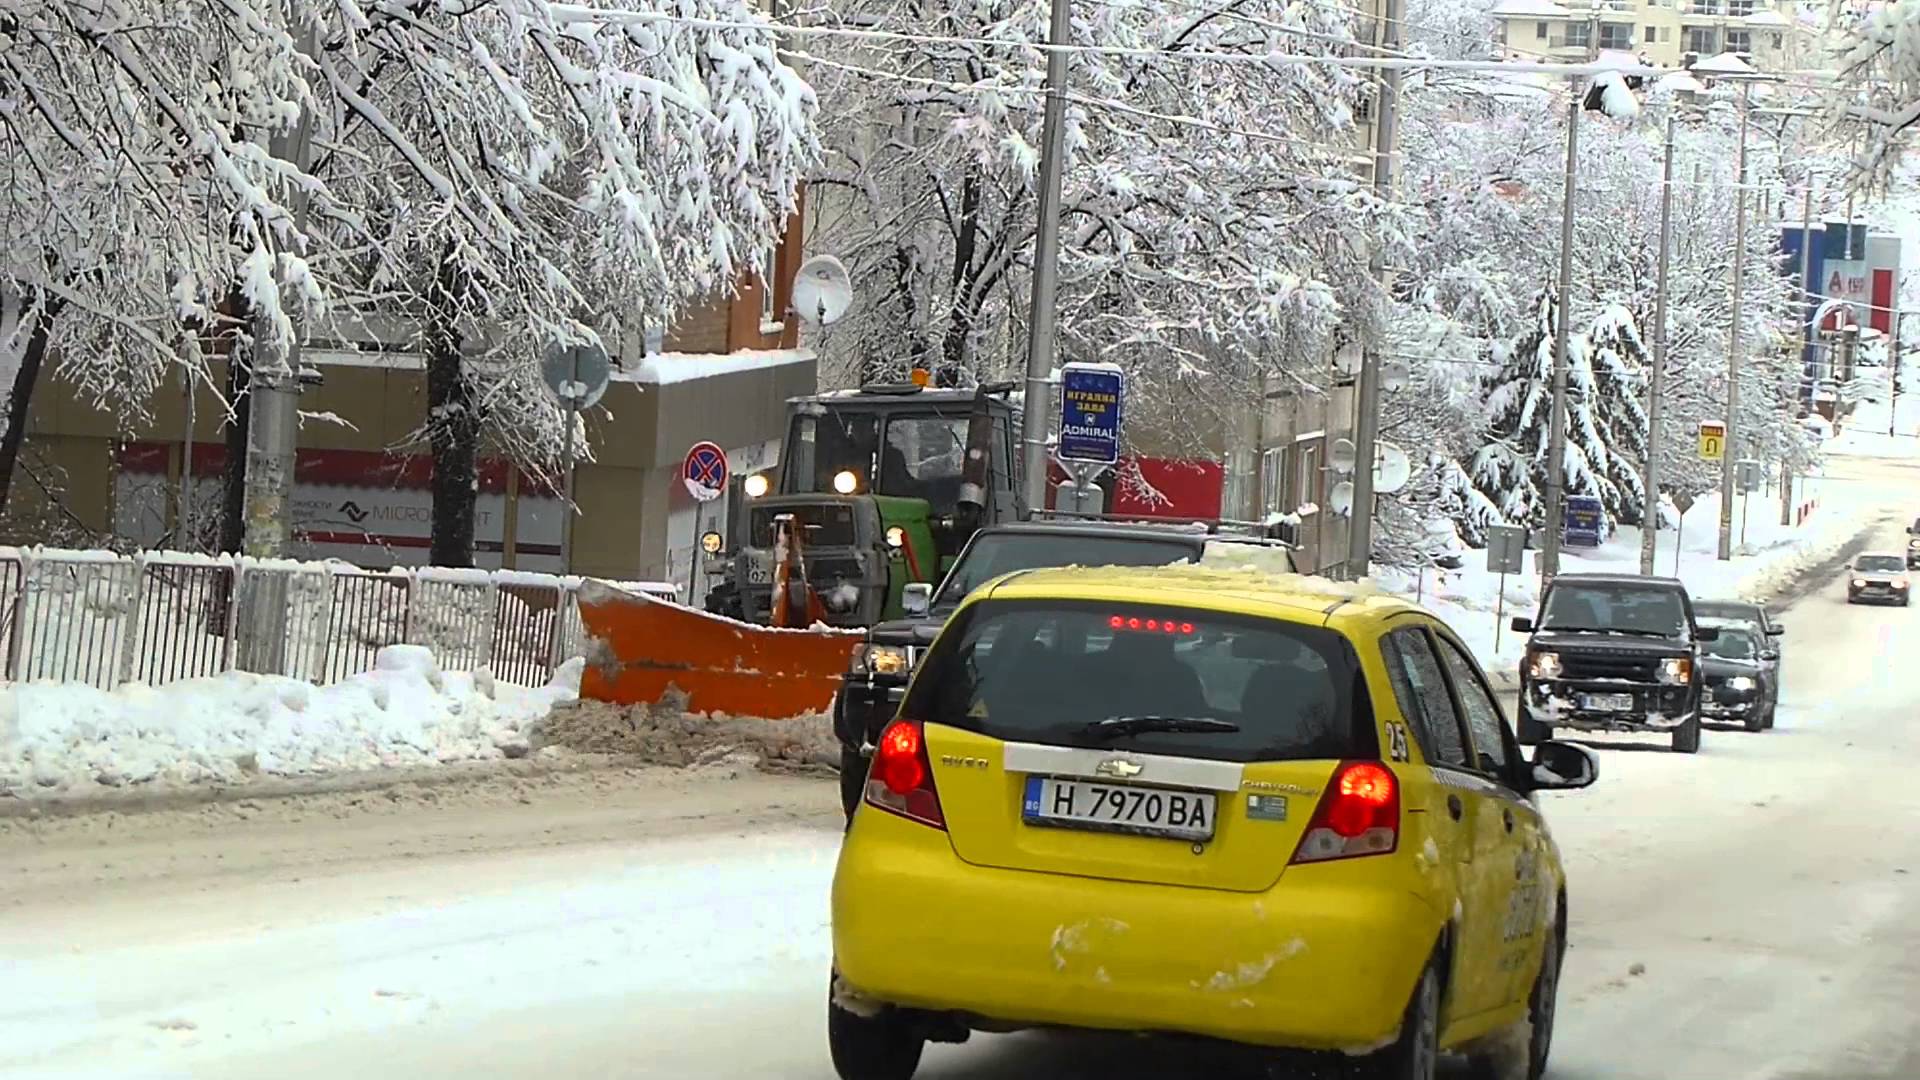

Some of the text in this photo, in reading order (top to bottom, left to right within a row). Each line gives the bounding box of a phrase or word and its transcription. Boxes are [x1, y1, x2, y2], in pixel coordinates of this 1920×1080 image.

[1062, 423, 1116, 440] ADMIRAL
[1385, 720, 1408, 761] 25
[1052, 783, 1207, 828] H 7970 BA
